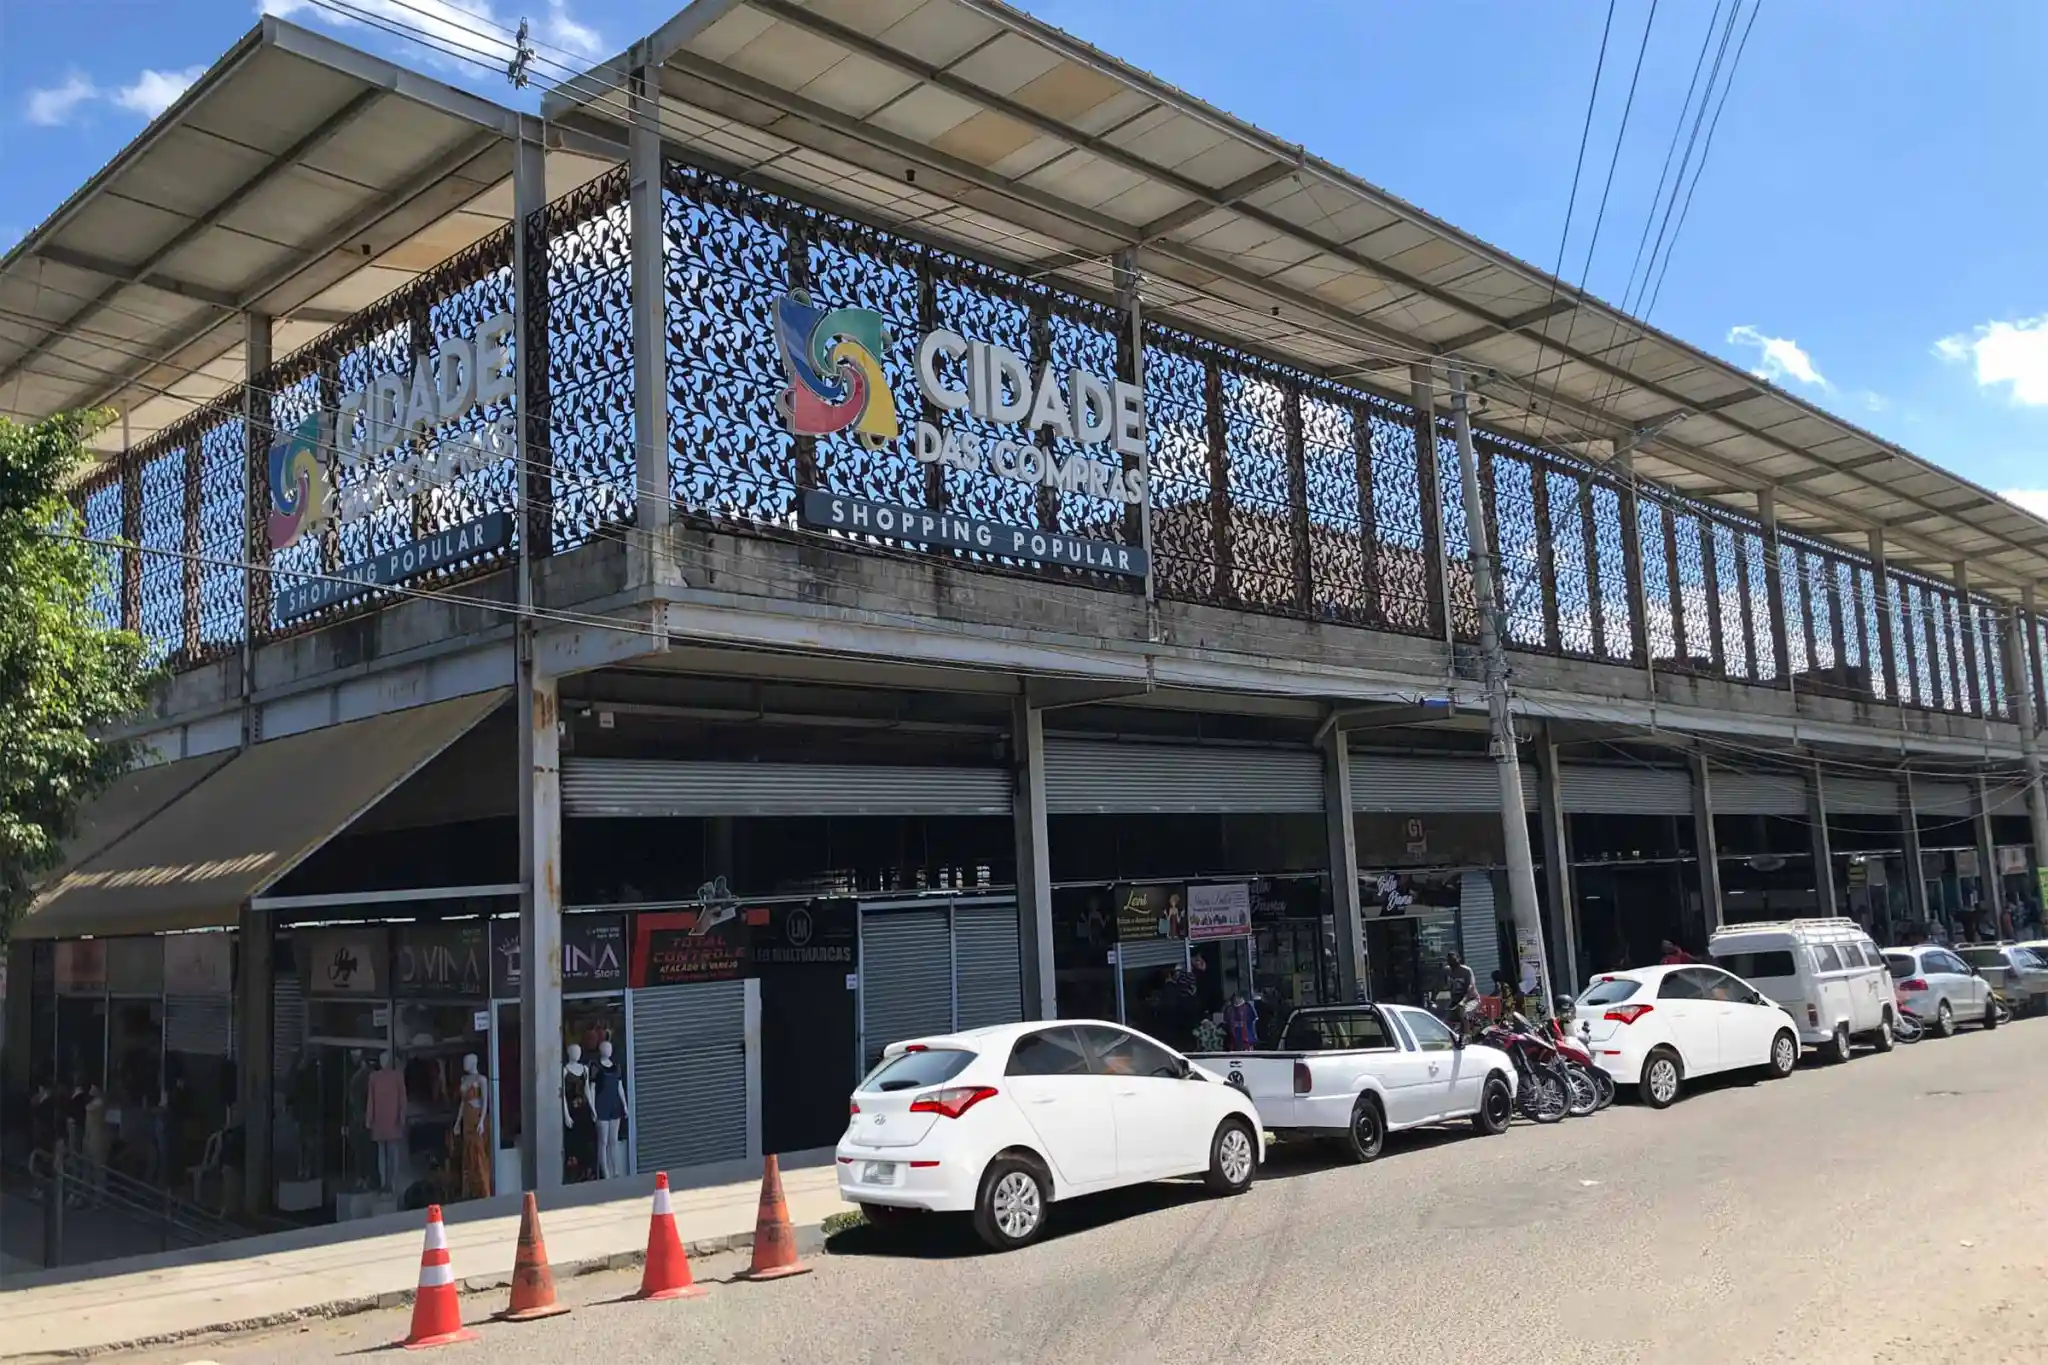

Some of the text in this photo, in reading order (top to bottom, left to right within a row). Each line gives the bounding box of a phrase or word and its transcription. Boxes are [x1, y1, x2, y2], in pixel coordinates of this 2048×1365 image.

[336, 312, 515, 471] CIDADE
[915, 328, 1145, 458] CIDADE
[915, 420, 1145, 505] DAS COMPRAS
[287, 521, 485, 612] SHOPPING POPULAR
[831, 499, 1131, 571] SHOPPING POPULAR
